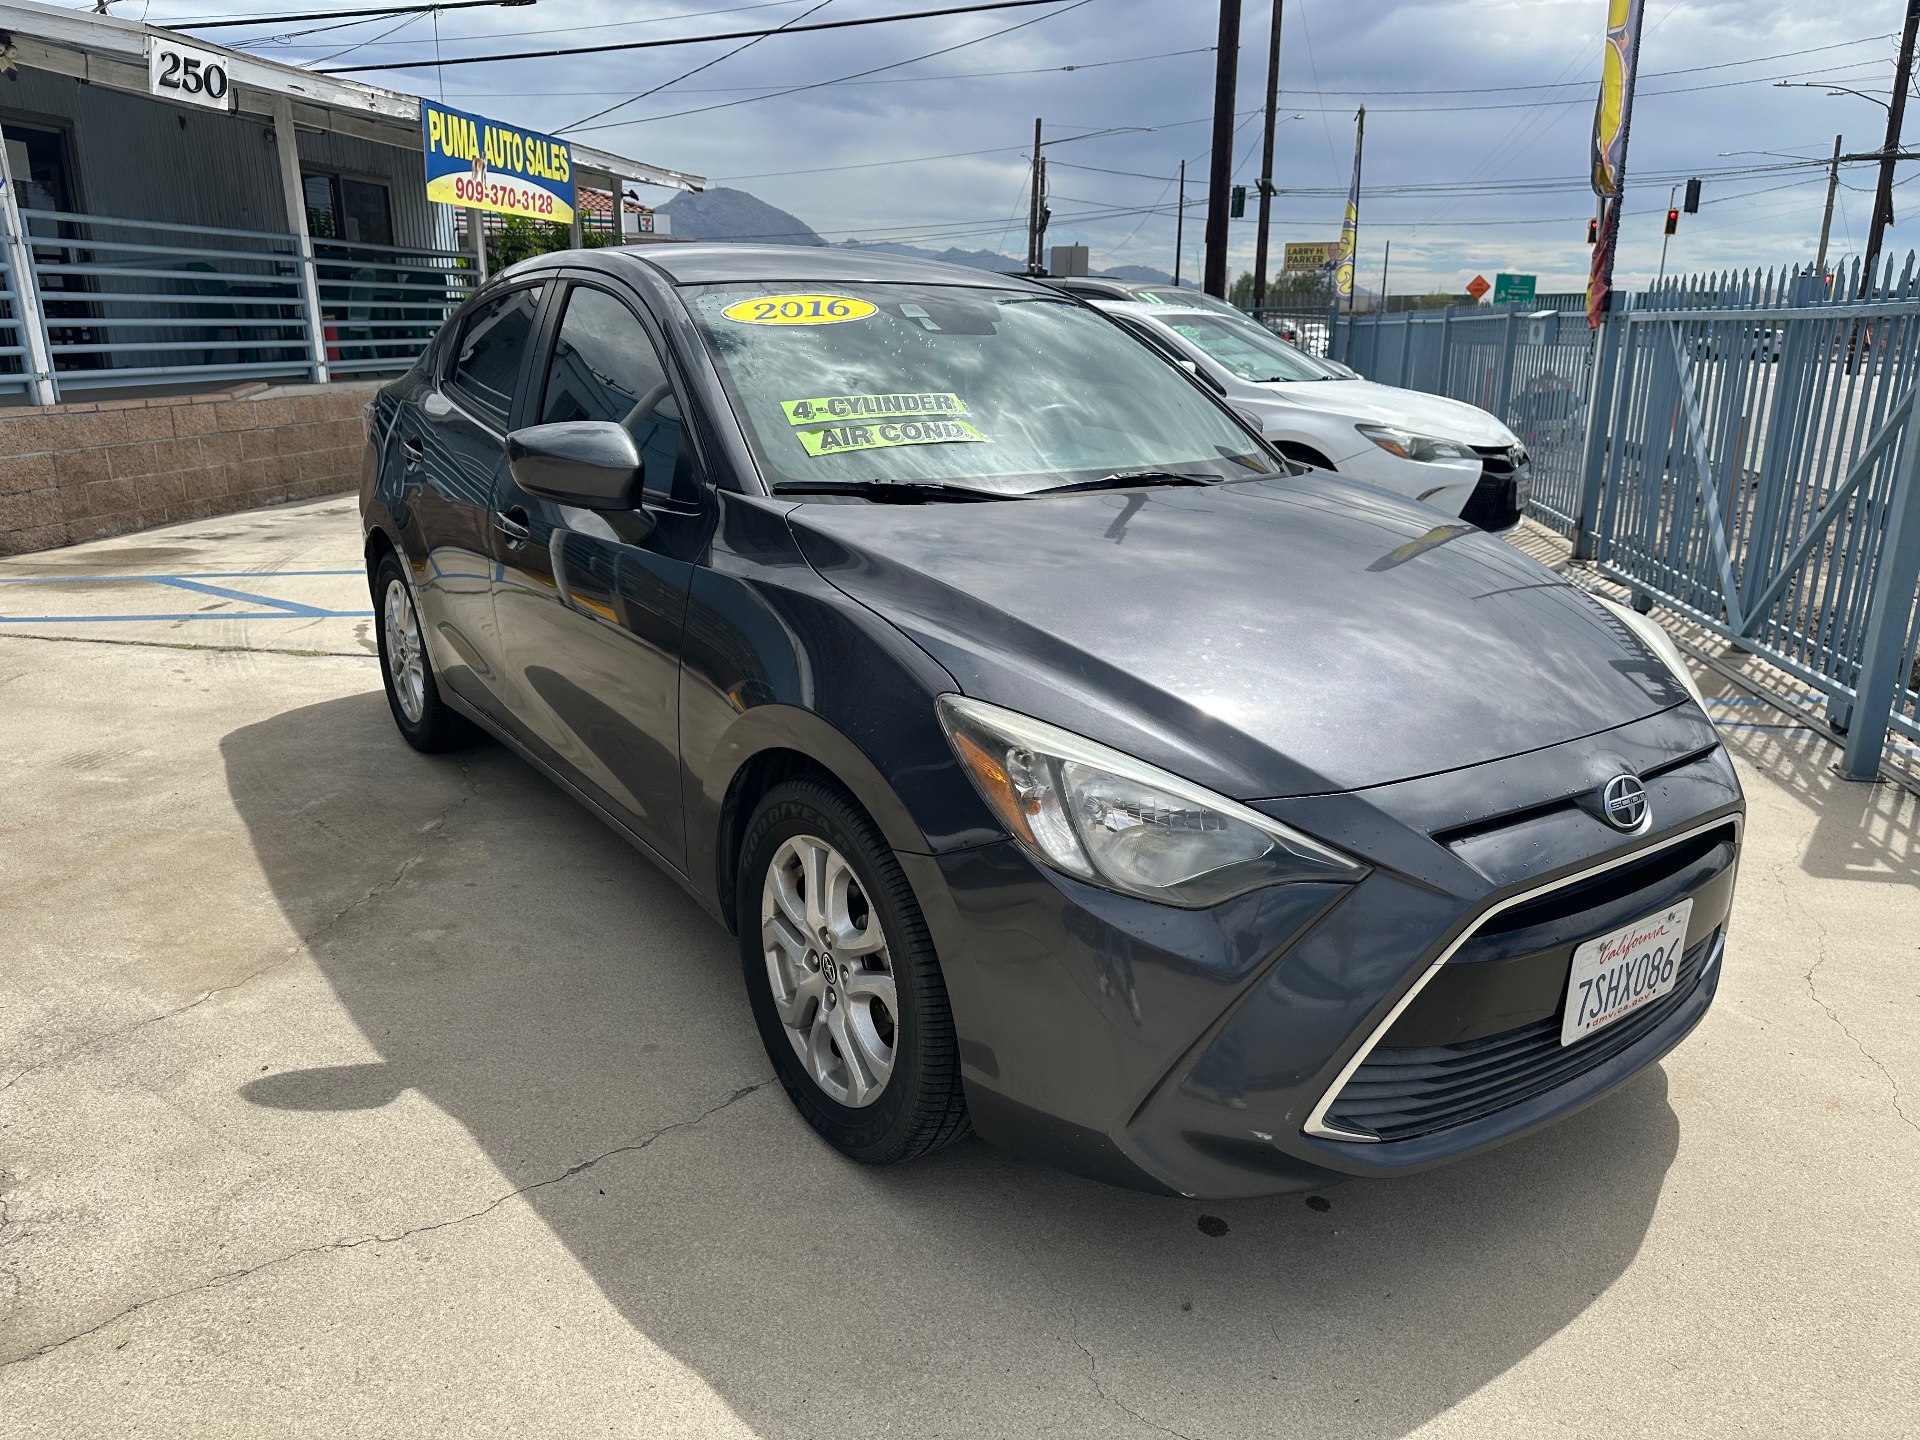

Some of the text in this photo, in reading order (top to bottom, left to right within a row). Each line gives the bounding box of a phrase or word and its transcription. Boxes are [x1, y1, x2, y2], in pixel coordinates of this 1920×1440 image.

[159, 50, 228, 99] 250
[427, 108, 570, 184] PUMA AUTO SALES
[455, 176, 553, 215] 909-370-3128
[1287, 247, 1315, 255] LARRY
[1287, 255, 1325, 264] PARKER
[753, 299, 851, 321] 2016
[792, 394, 958, 420] 4-CYLINDER
[820, 426, 875, 452] AIR
[1599, 924, 1670, 965] California
[1577, 937, 1680, 1027] 7SHX086
[1592, 992, 1651, 1028] dmv.ca.gov
